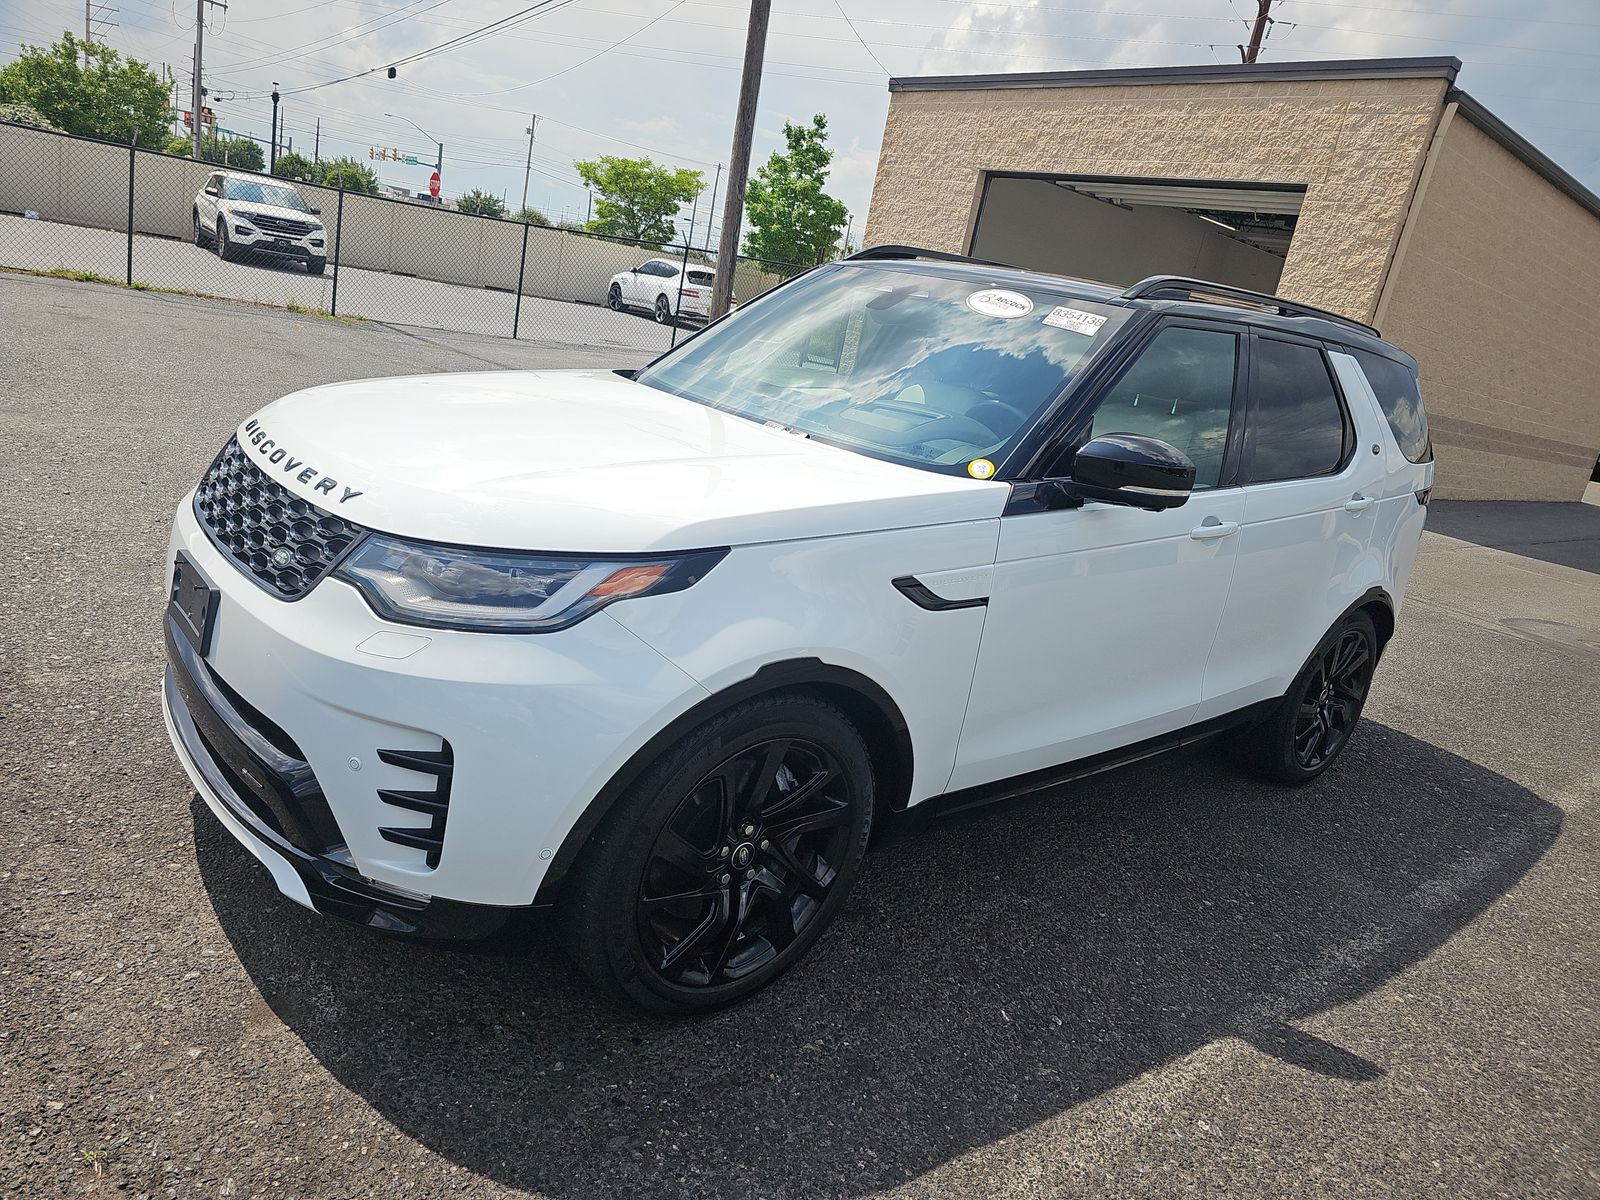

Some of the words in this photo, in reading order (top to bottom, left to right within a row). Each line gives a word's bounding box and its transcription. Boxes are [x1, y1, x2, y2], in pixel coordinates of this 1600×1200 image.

[995, 296, 1027, 311] ADCOCK
[1052, 308, 1105, 327] 8354138
[245, 418, 363, 503] DISCOVERY
[932, 572, 989, 586] DISCOVE
